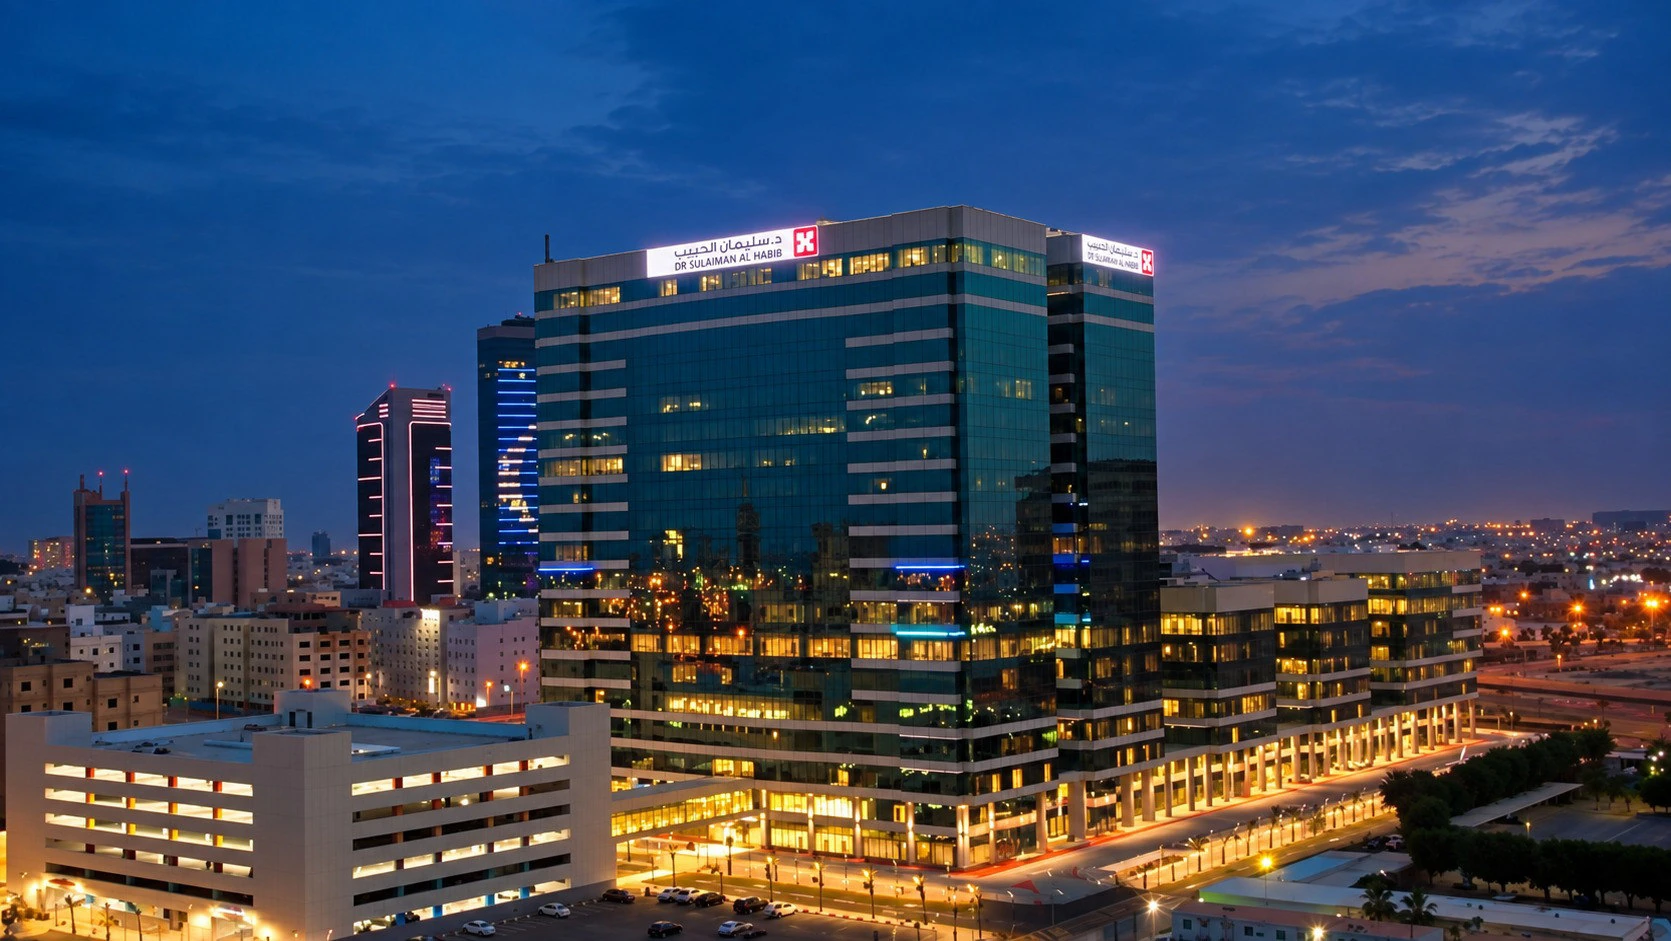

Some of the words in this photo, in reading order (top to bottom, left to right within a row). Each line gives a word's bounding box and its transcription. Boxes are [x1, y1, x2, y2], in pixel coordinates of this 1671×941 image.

[674, 242, 717, 260] الحبيب
[720, 236, 782, 253] د.سليمان
[674, 261, 687, 271] DR
[690, 254, 737, 269] SULAIMAN
[739, 252, 751, 262] AL
[753, 249, 783, 260] HABIB
